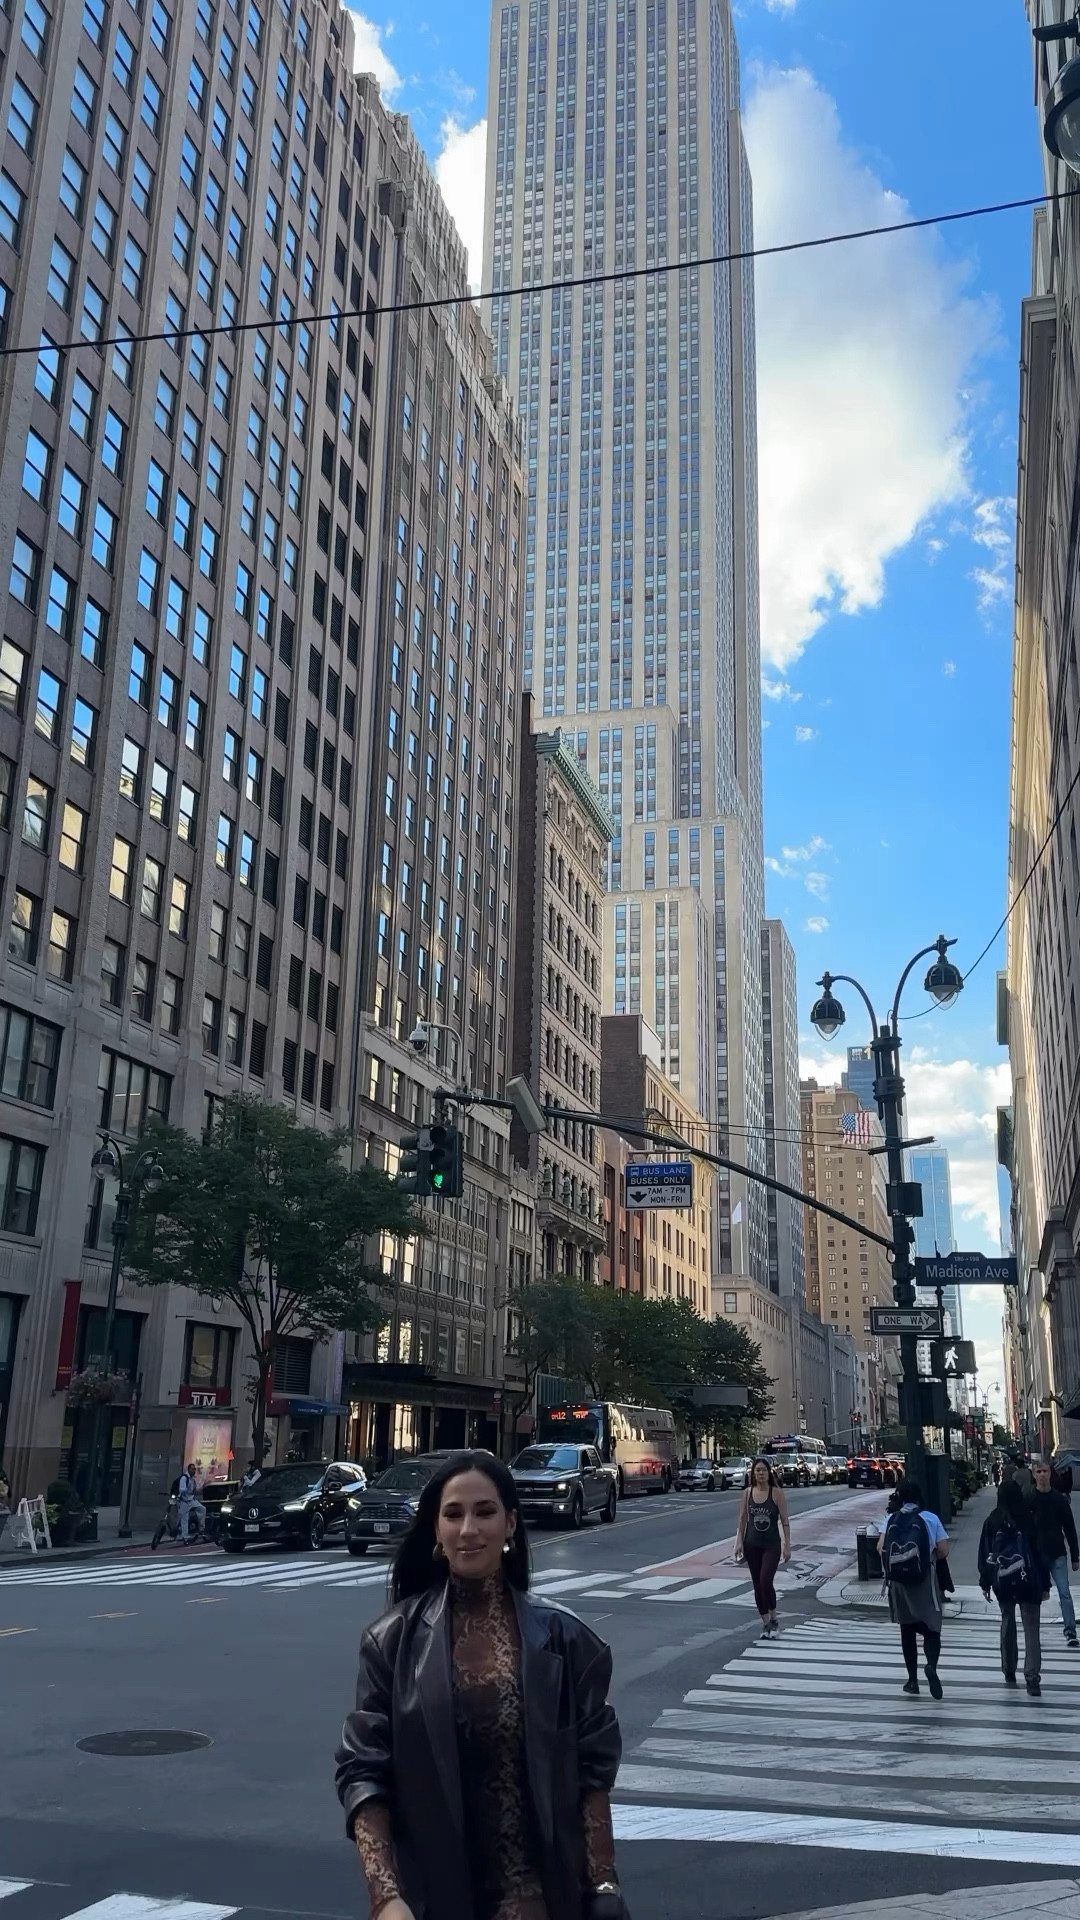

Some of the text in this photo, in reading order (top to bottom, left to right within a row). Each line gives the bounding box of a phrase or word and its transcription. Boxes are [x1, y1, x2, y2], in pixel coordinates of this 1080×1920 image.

[663, 1176, 686, 1184] ONLY
[670, 1186, 686, 1194] 7PM
[650, 1195, 683, 1203] MON-FRI
[925, 1265, 1009, 1278] Madison Ave
[883, 1314, 930, 1325] ONE WAY
